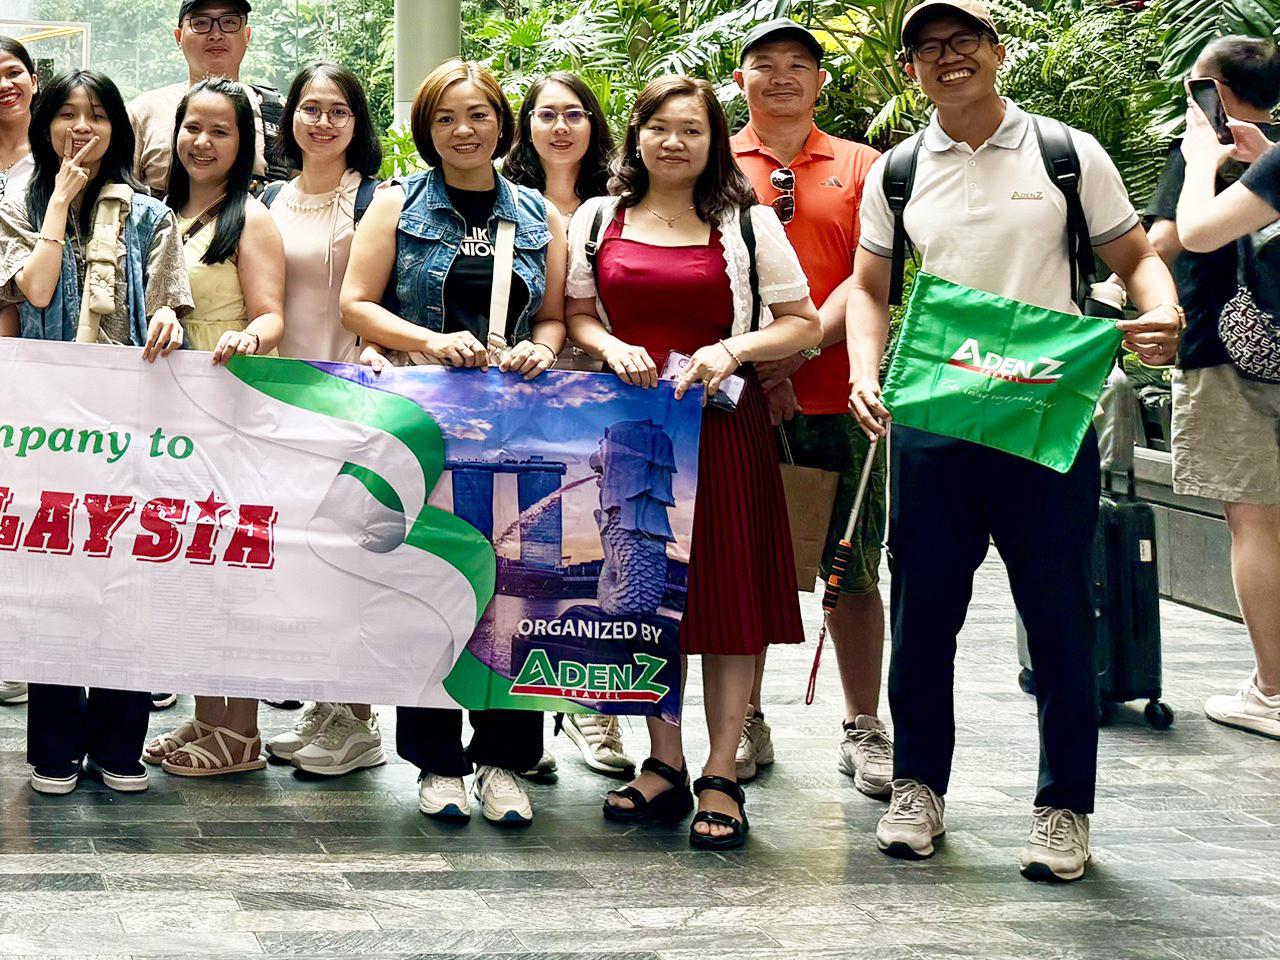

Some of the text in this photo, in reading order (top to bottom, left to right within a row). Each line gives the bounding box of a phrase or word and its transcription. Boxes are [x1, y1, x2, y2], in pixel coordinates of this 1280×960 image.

[951, 338, 1066, 380] ADENZ
[150, 428, 194, 459] to
[519, 619, 663, 644] ORGANIZED BY
[512, 649, 670, 696] ADENZ
[560, 689, 621, 700] TRAVEL
